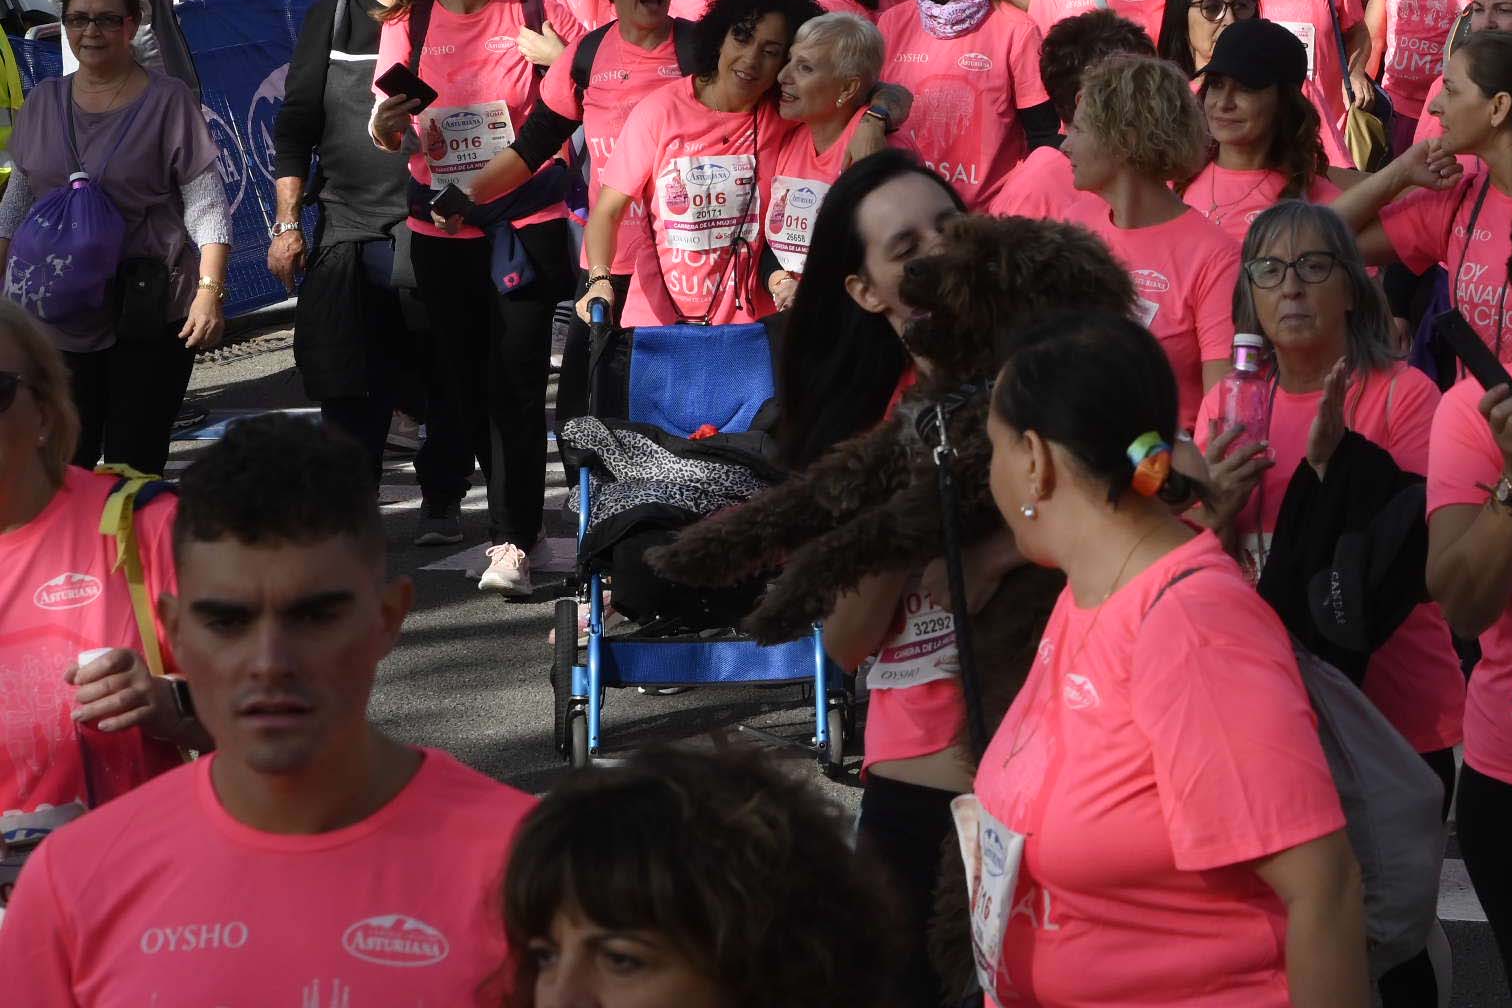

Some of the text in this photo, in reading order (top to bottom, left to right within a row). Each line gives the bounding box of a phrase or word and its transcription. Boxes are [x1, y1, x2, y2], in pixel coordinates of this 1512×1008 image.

[445, 117, 481, 128] ASTURIANA
[449, 135, 482, 151] 016
[456, 152, 478, 162] 9113
[692, 191, 727, 207] 016
[695, 209, 722, 220] 20171
[785, 215, 808, 230] 016
[38, 584, 101, 605] ASTURIANA
[913, 615, 952, 637] 32292
[139, 920, 249, 956] OYSHO
[348, 927, 444, 955] ASTURIANA
